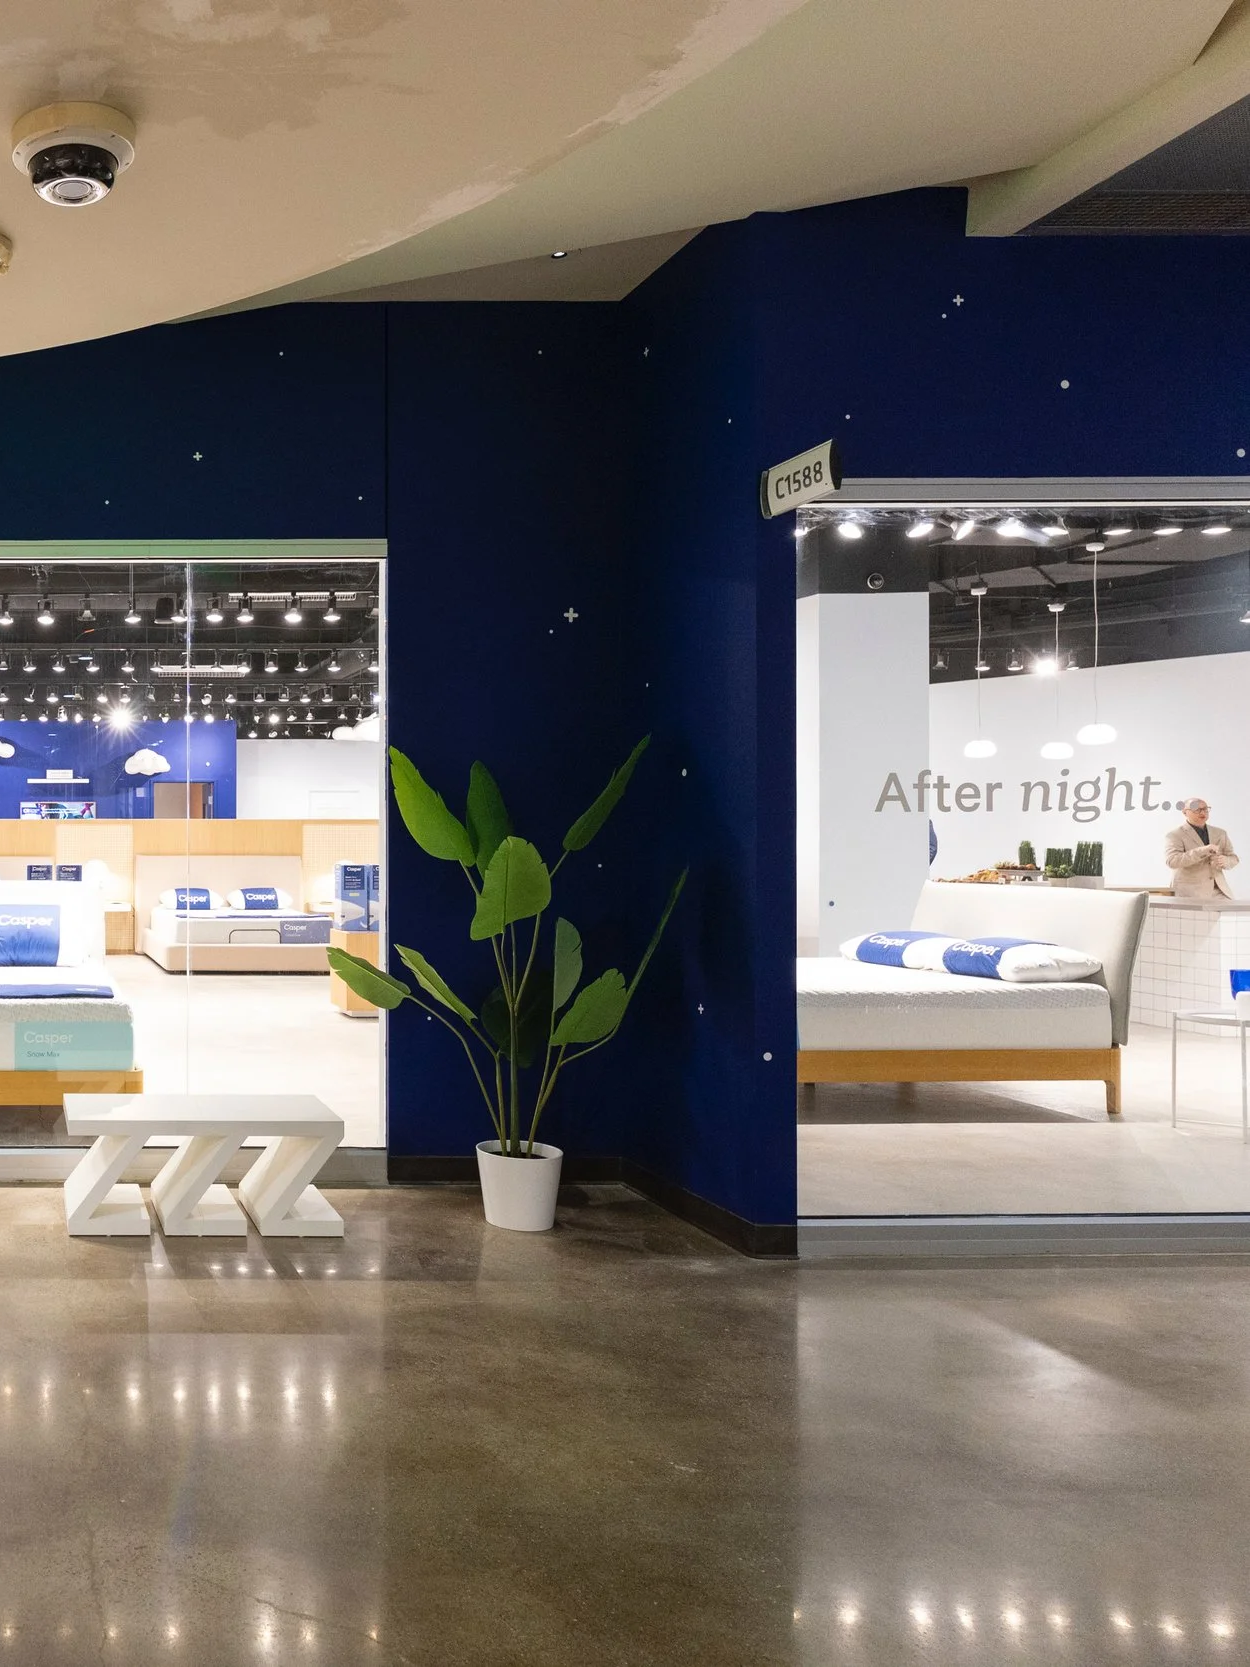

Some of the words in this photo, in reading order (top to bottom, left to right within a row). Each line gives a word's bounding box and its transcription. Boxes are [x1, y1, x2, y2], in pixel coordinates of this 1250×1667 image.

[775, 461, 823, 499] C1588
[874, 769, 1002, 813] After
[178, 894, 207, 904] Casper
[246, 893, 276, 902] Casper
[283, 924, 307, 932] Casper
[868, 935, 910, 948] Casper
[952, 941, 1000, 956] Casper
[24, 1031, 73, 1047] Casper
